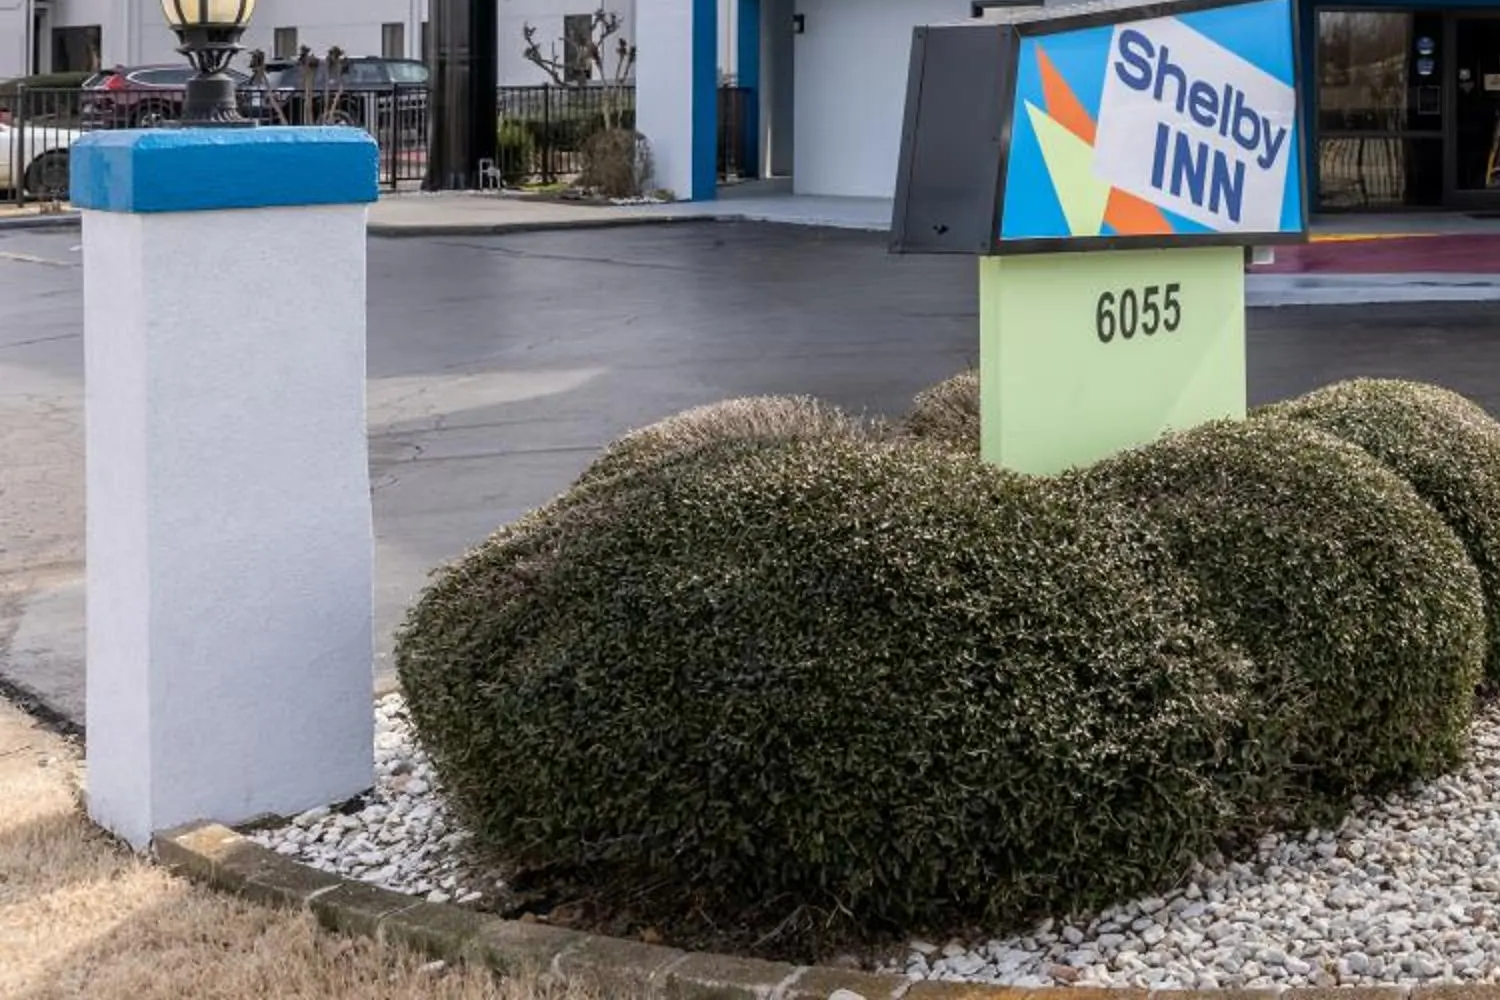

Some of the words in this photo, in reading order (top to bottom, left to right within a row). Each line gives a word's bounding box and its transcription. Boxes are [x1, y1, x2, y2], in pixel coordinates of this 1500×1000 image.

[1114, 28, 1287, 170] Shelby
[1151, 123, 1245, 223] INN
[1095, 282, 1182, 343] 6055
